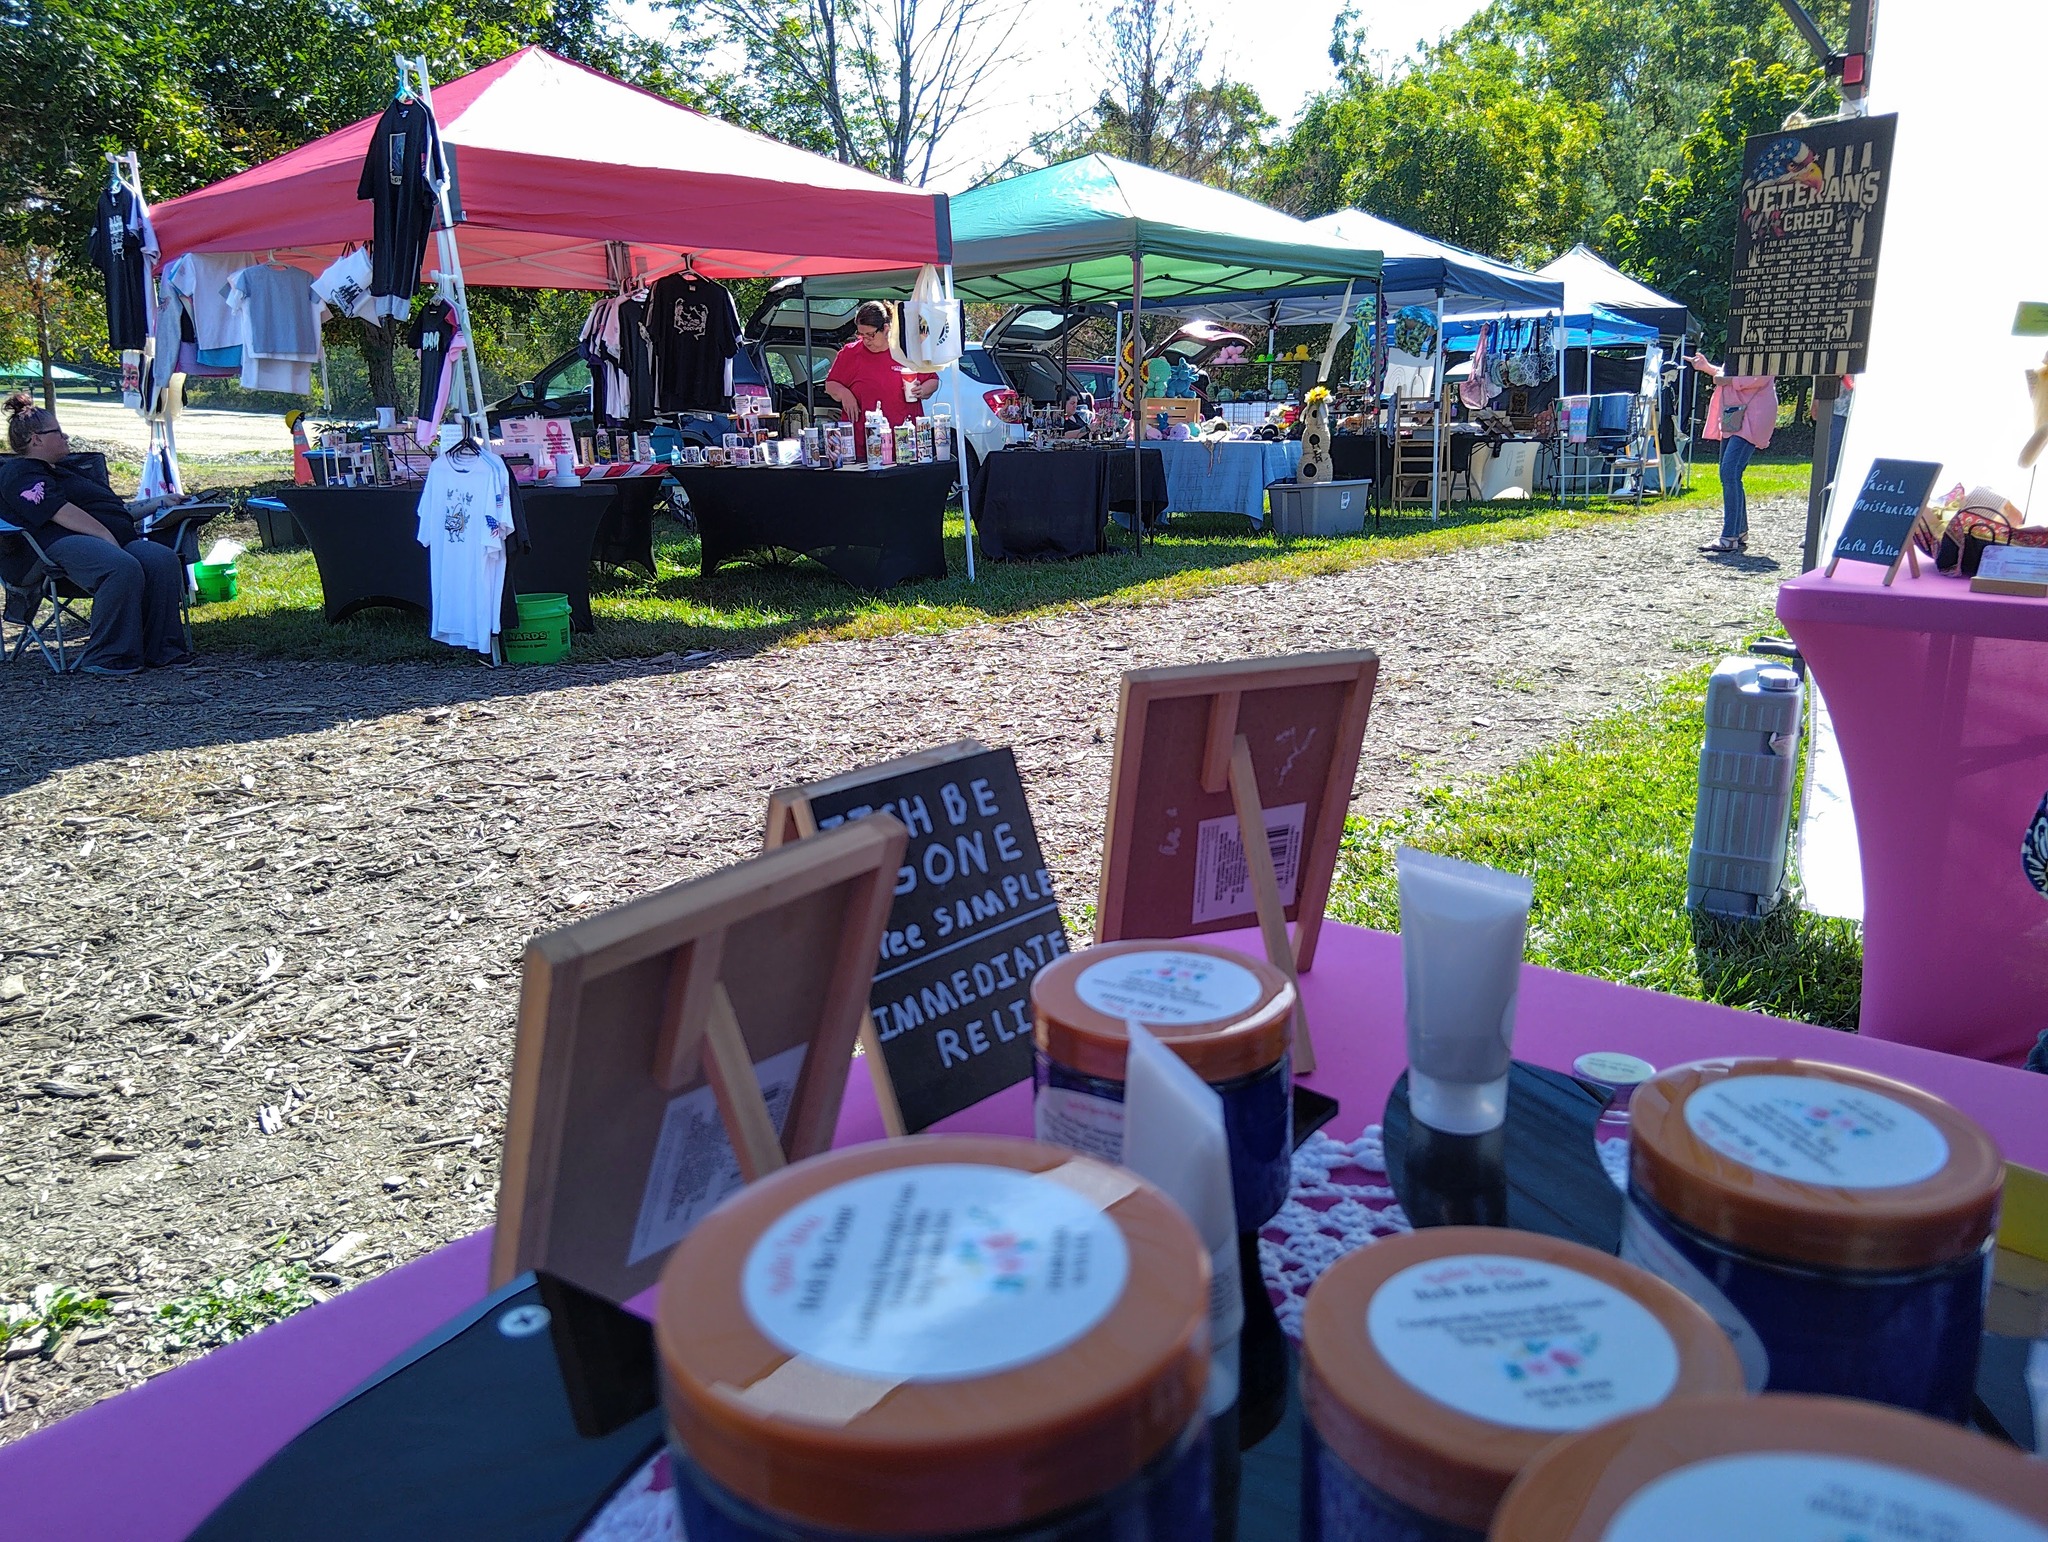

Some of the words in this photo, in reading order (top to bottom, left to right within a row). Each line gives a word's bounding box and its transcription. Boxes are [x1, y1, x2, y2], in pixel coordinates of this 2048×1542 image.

[1747, 171, 1881, 212] VETERAN'S
[1783, 208, 1833, 232] CREED
[1787, 237, 1818, 246] AMERICAN
[1819, 233, 1847, 243] VETERAN
[1762, 252, 1788, 261] PROUDLY
[1789, 250, 1812, 259] SERVED
[1813, 249, 1822, 257] MY
[1823, 246, 1851, 255] COUNTRY
[1765, 266, 1788, 274] VALUES
[1792, 263, 1819, 272] LEARNED
[1829, 261, 1841, 269] THE
[1843, 258, 1873, 268] MILITARY
[1735, 281, 1761, 289] CONTINUE
[1771, 278, 1790, 286] SERVE
[1782, 291, 1804, 299] FELLOW
[1806, 289, 1838, 297] VETERANS
[1733, 307, 1759, 315] MAINTAIN
[1760, 306, 1769, 314] MY
[1769, 304, 1798, 313] PHYSICAL
[1800, 303, 1811, 311] AND
[1812, 302, 1835, 310] MENTAL
[1836, 300, 1872, 309] DISCIPLINE
[1751, 319, 1780, 327] CONTINUE
[1789, 317, 1805, 325] LEAD
[1818, 315, 1846, 323] IMPROVE
[1768, 331, 1784, 339] MAKE
[1790, 329, 1826, 337] DIFFERENCE
[1764, 344, 1797, 352] REMEMBER
[1807, 343, 1828, 351] FALLEN
[505, 630, 548, 641] NARDS
[940, 778, 1000, 826] BE
[879, 923, 927, 960] ree
[932, 868, 1053, 937] SAMPLE
[872, 930, 1066, 1042] IMMEDIATE
[935, 999, 1033, 1069] RELI
